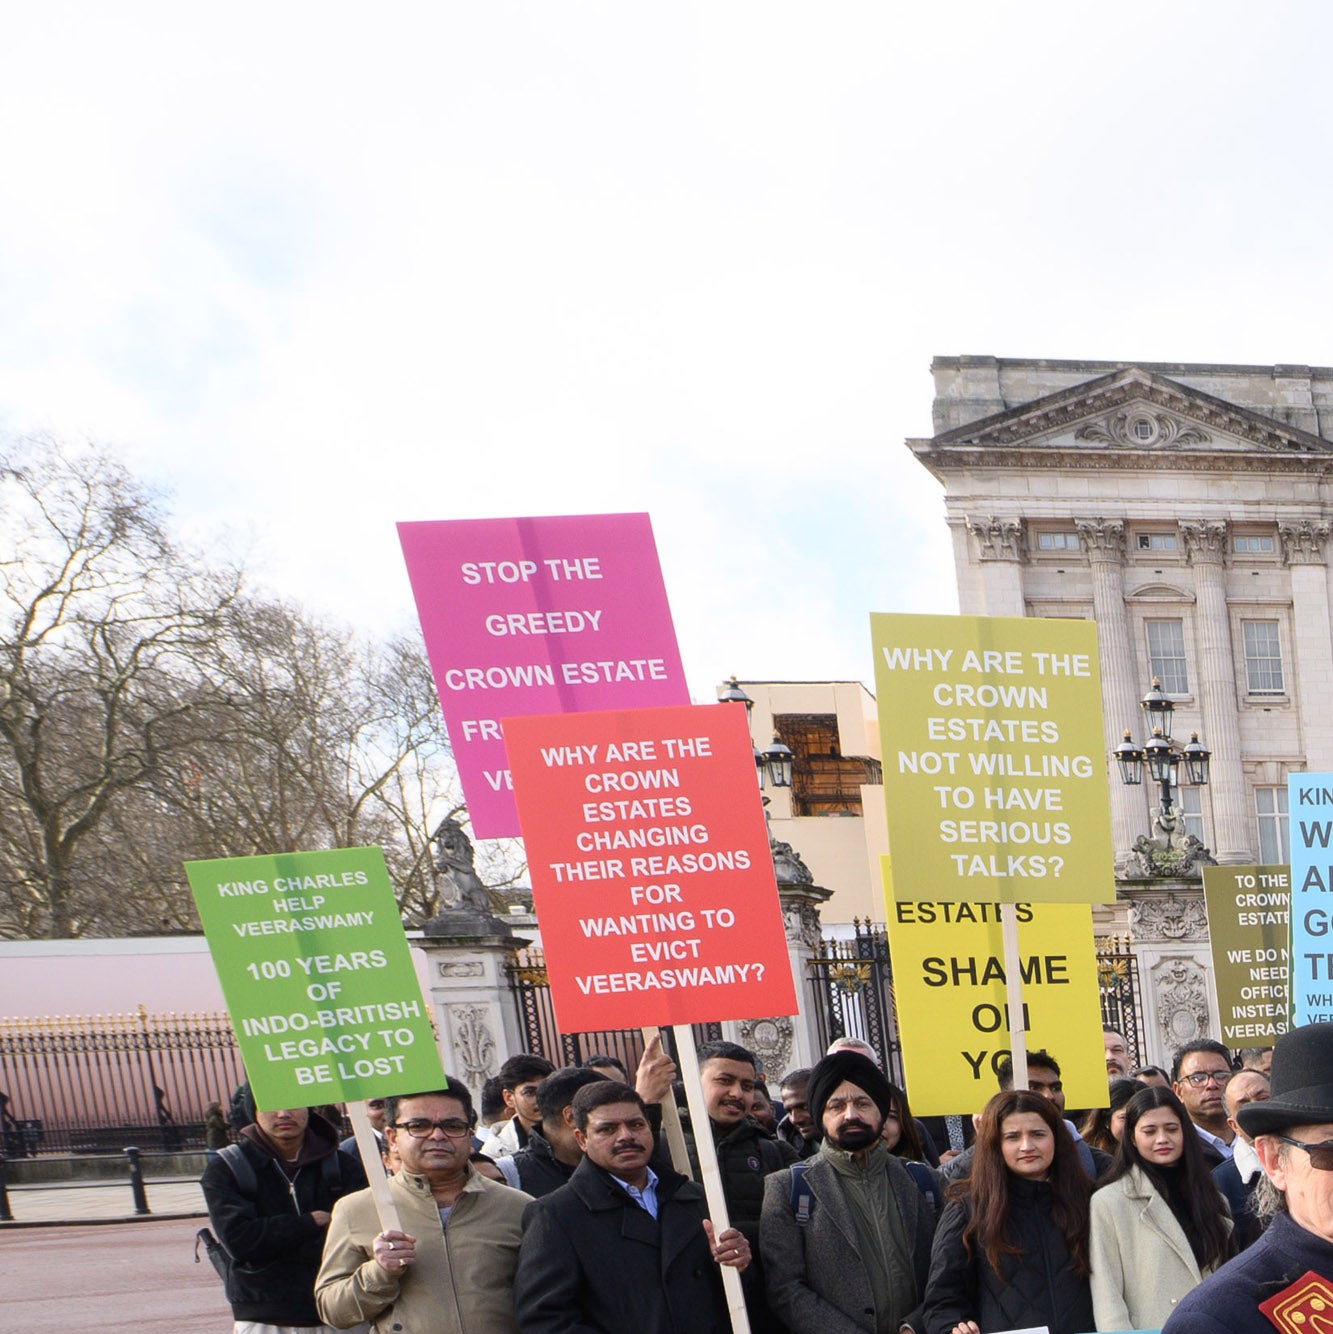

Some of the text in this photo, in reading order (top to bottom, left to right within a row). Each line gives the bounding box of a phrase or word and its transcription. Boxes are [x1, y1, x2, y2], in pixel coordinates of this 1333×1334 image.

[461, 558, 603, 584] STOP THE
[486, 610, 601, 636] GREEDY
[446, 659, 667, 690] CROWN ESTATE
[883, 647, 1091, 676] WHY ARE THE
[934, 683, 1047, 709] CROWN
[928, 718, 1059, 743] ESTATES
[541, 737, 712, 768] WHY ARE THE
[898, 752, 1092, 778] NOT WILLING
[585, 769, 679, 793] CROWN
[583, 797, 691, 822] ESTATES
[934, 786, 1063, 810] TO HAVE
[577, 825, 708, 851] CHANGING
[940, 820, 1071, 844] SERIOUS
[550, 850, 750, 882] THEIR REASONS
[951, 855, 1064, 877] TALKS?
[218, 871, 368, 897] KING CHARLES
[1235, 874, 1288, 888] TO THE
[273, 895, 325, 912] HELP
[631, 884, 683, 905] FOR
[233, 911, 373, 937] VEERASWAMY
[579, 909, 734, 937] WANTING TO
[631, 939, 701, 962] EVICT
[1227, 950, 1252, 963] WE
[1256, 949, 1277, 962] DO
[247, 950, 387, 980] 100 YEARS
[307, 982, 341, 1001] OF
[576, 963, 764, 994] VEERASWAMY?
[242, 1001, 421, 1036] INDO-BRITISH
[264, 1028, 414, 1061] LEGACY TO
[295, 1055, 404, 1085] BE LOST
